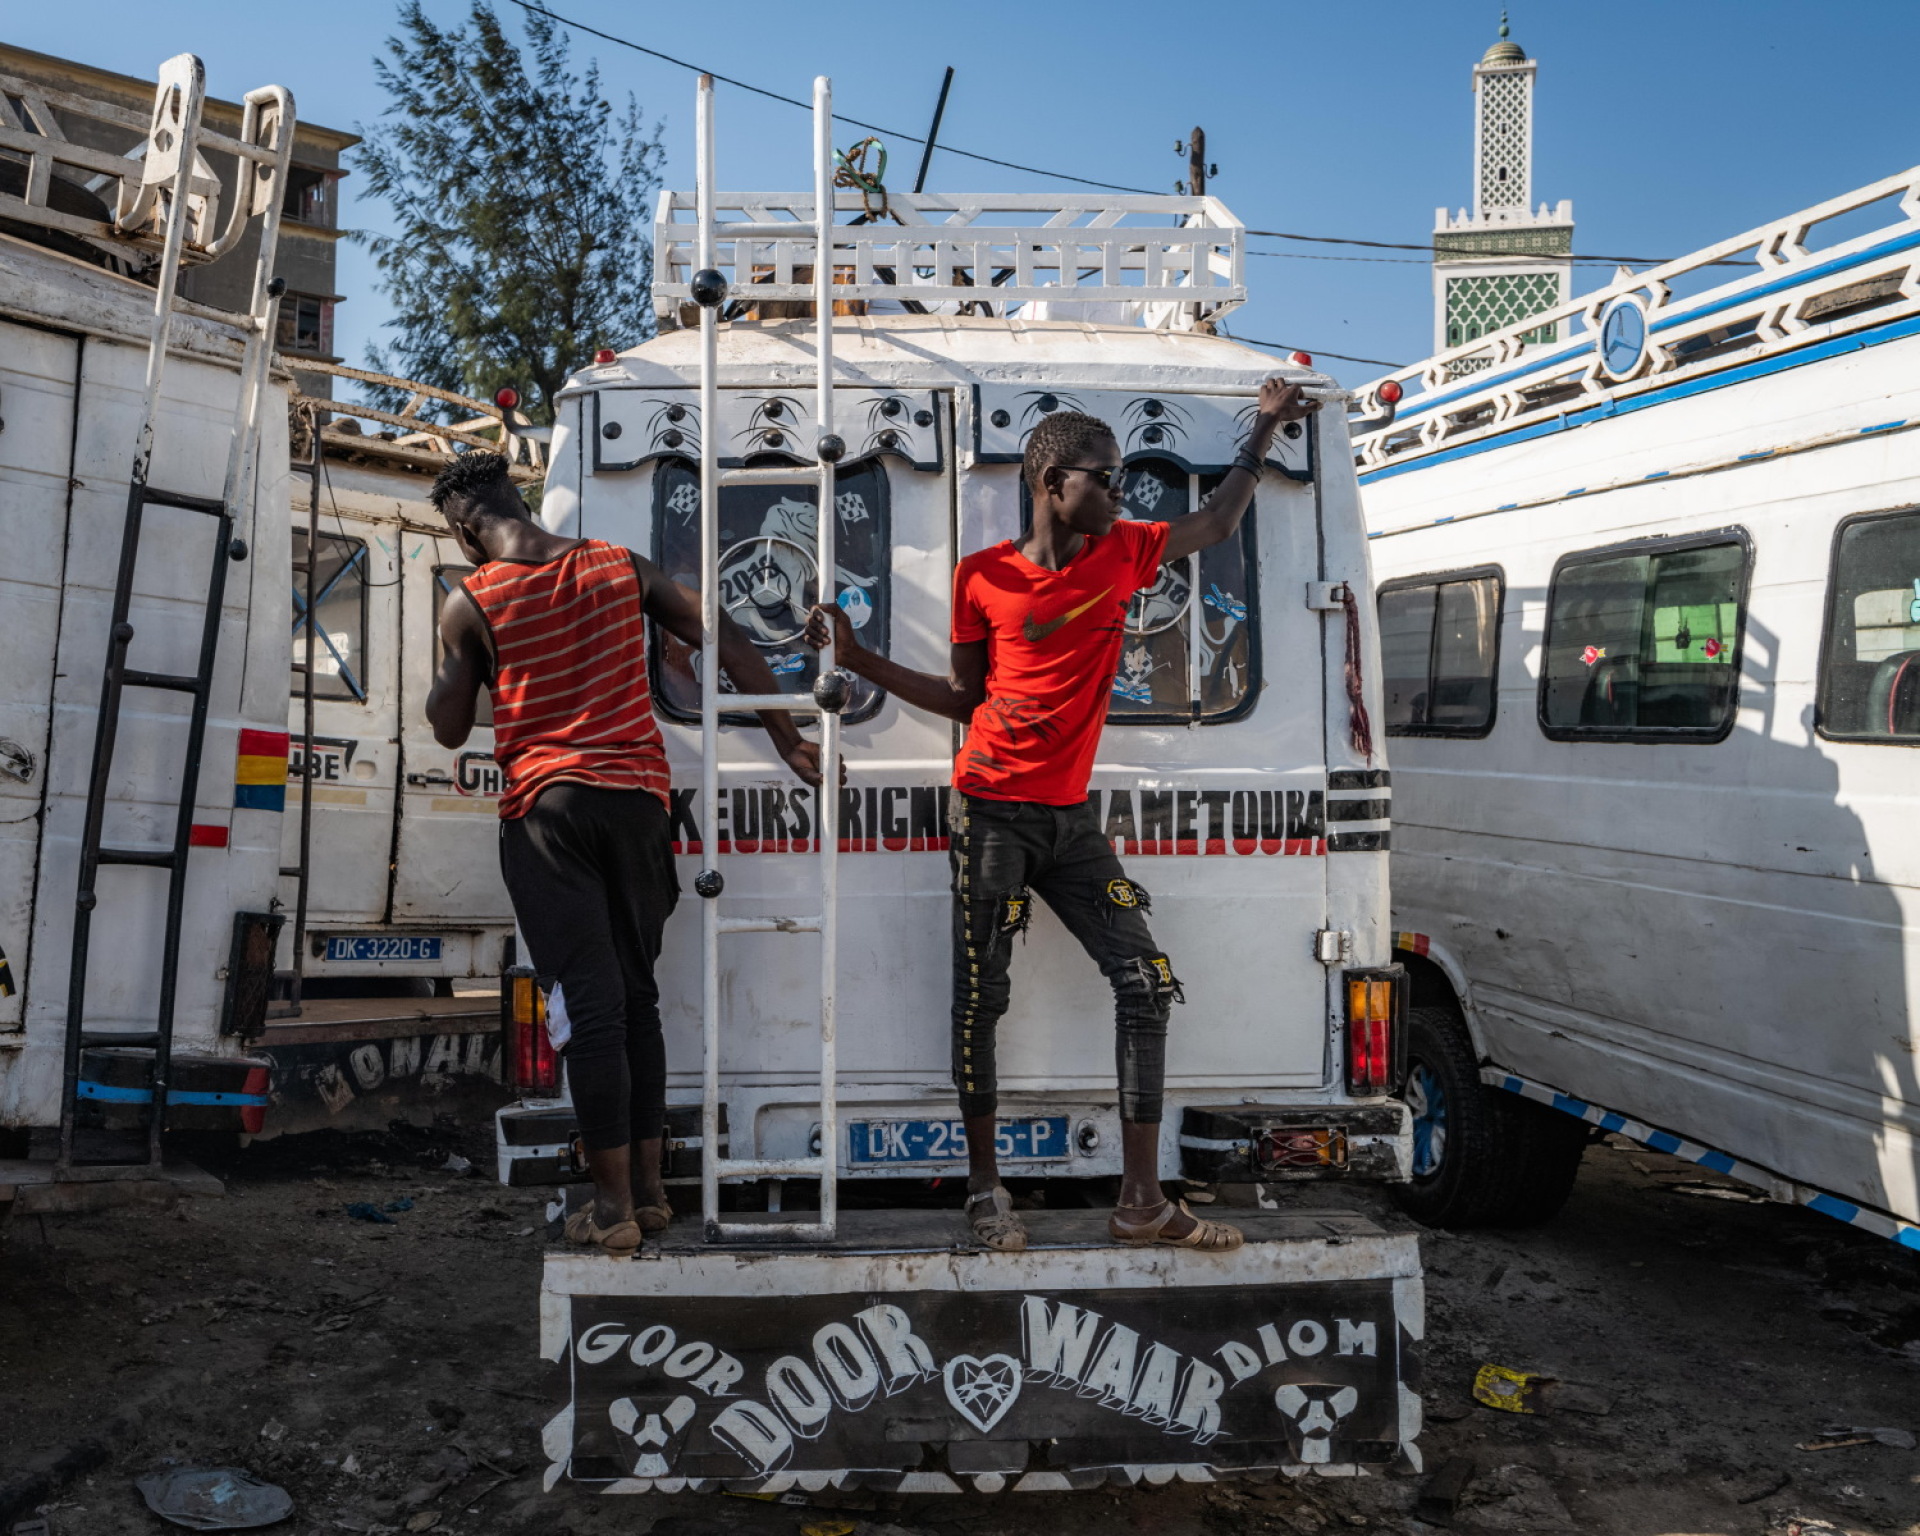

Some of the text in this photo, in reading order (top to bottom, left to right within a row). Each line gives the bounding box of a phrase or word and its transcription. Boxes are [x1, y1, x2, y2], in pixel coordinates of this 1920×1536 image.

[719, 554, 781, 605] 2018
[335, 938, 431, 959] DK-3220-G
[868, 1120, 1050, 1158] DK-255-P
[577, 1294, 1377, 1476] GOOR DOOR WAAR DIOM
